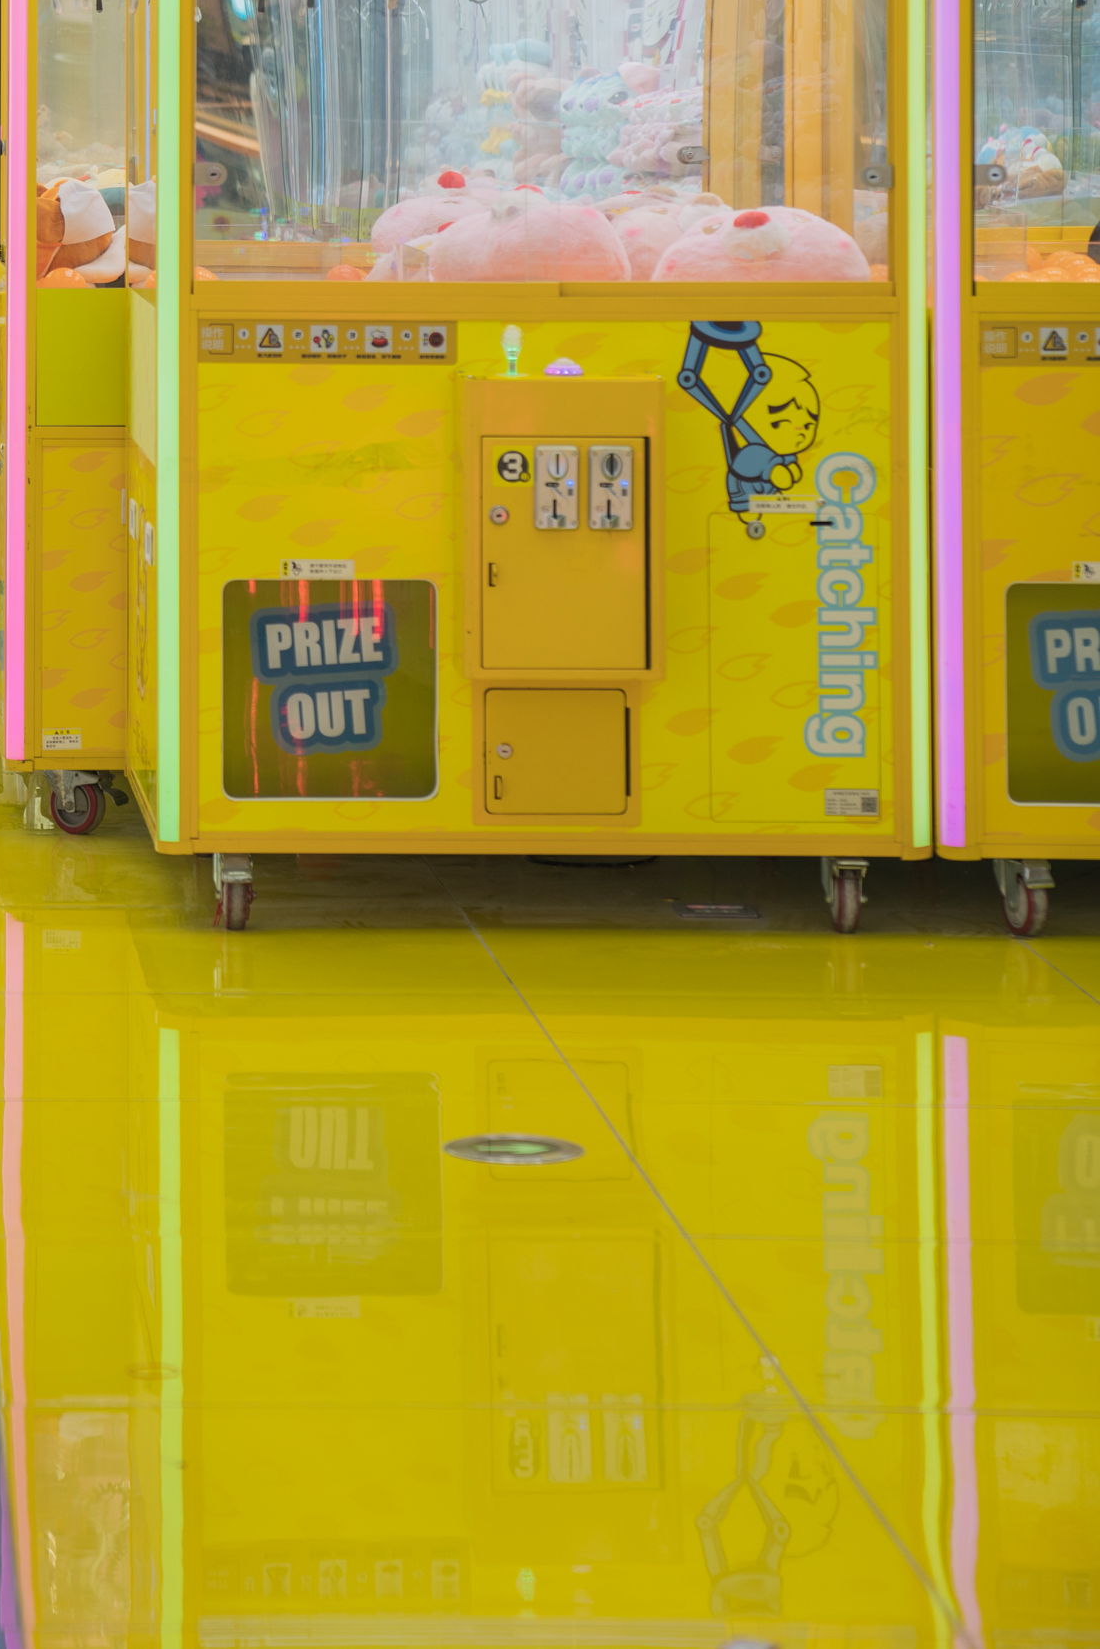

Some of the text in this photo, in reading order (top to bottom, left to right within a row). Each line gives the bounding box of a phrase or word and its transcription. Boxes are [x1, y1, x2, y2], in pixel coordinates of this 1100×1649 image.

[502, 452, 524, 481] 3
[804, 451, 878, 757] Catching
[265, 616, 383, 669] PRIZE
[286, 689, 370, 740] OUT
